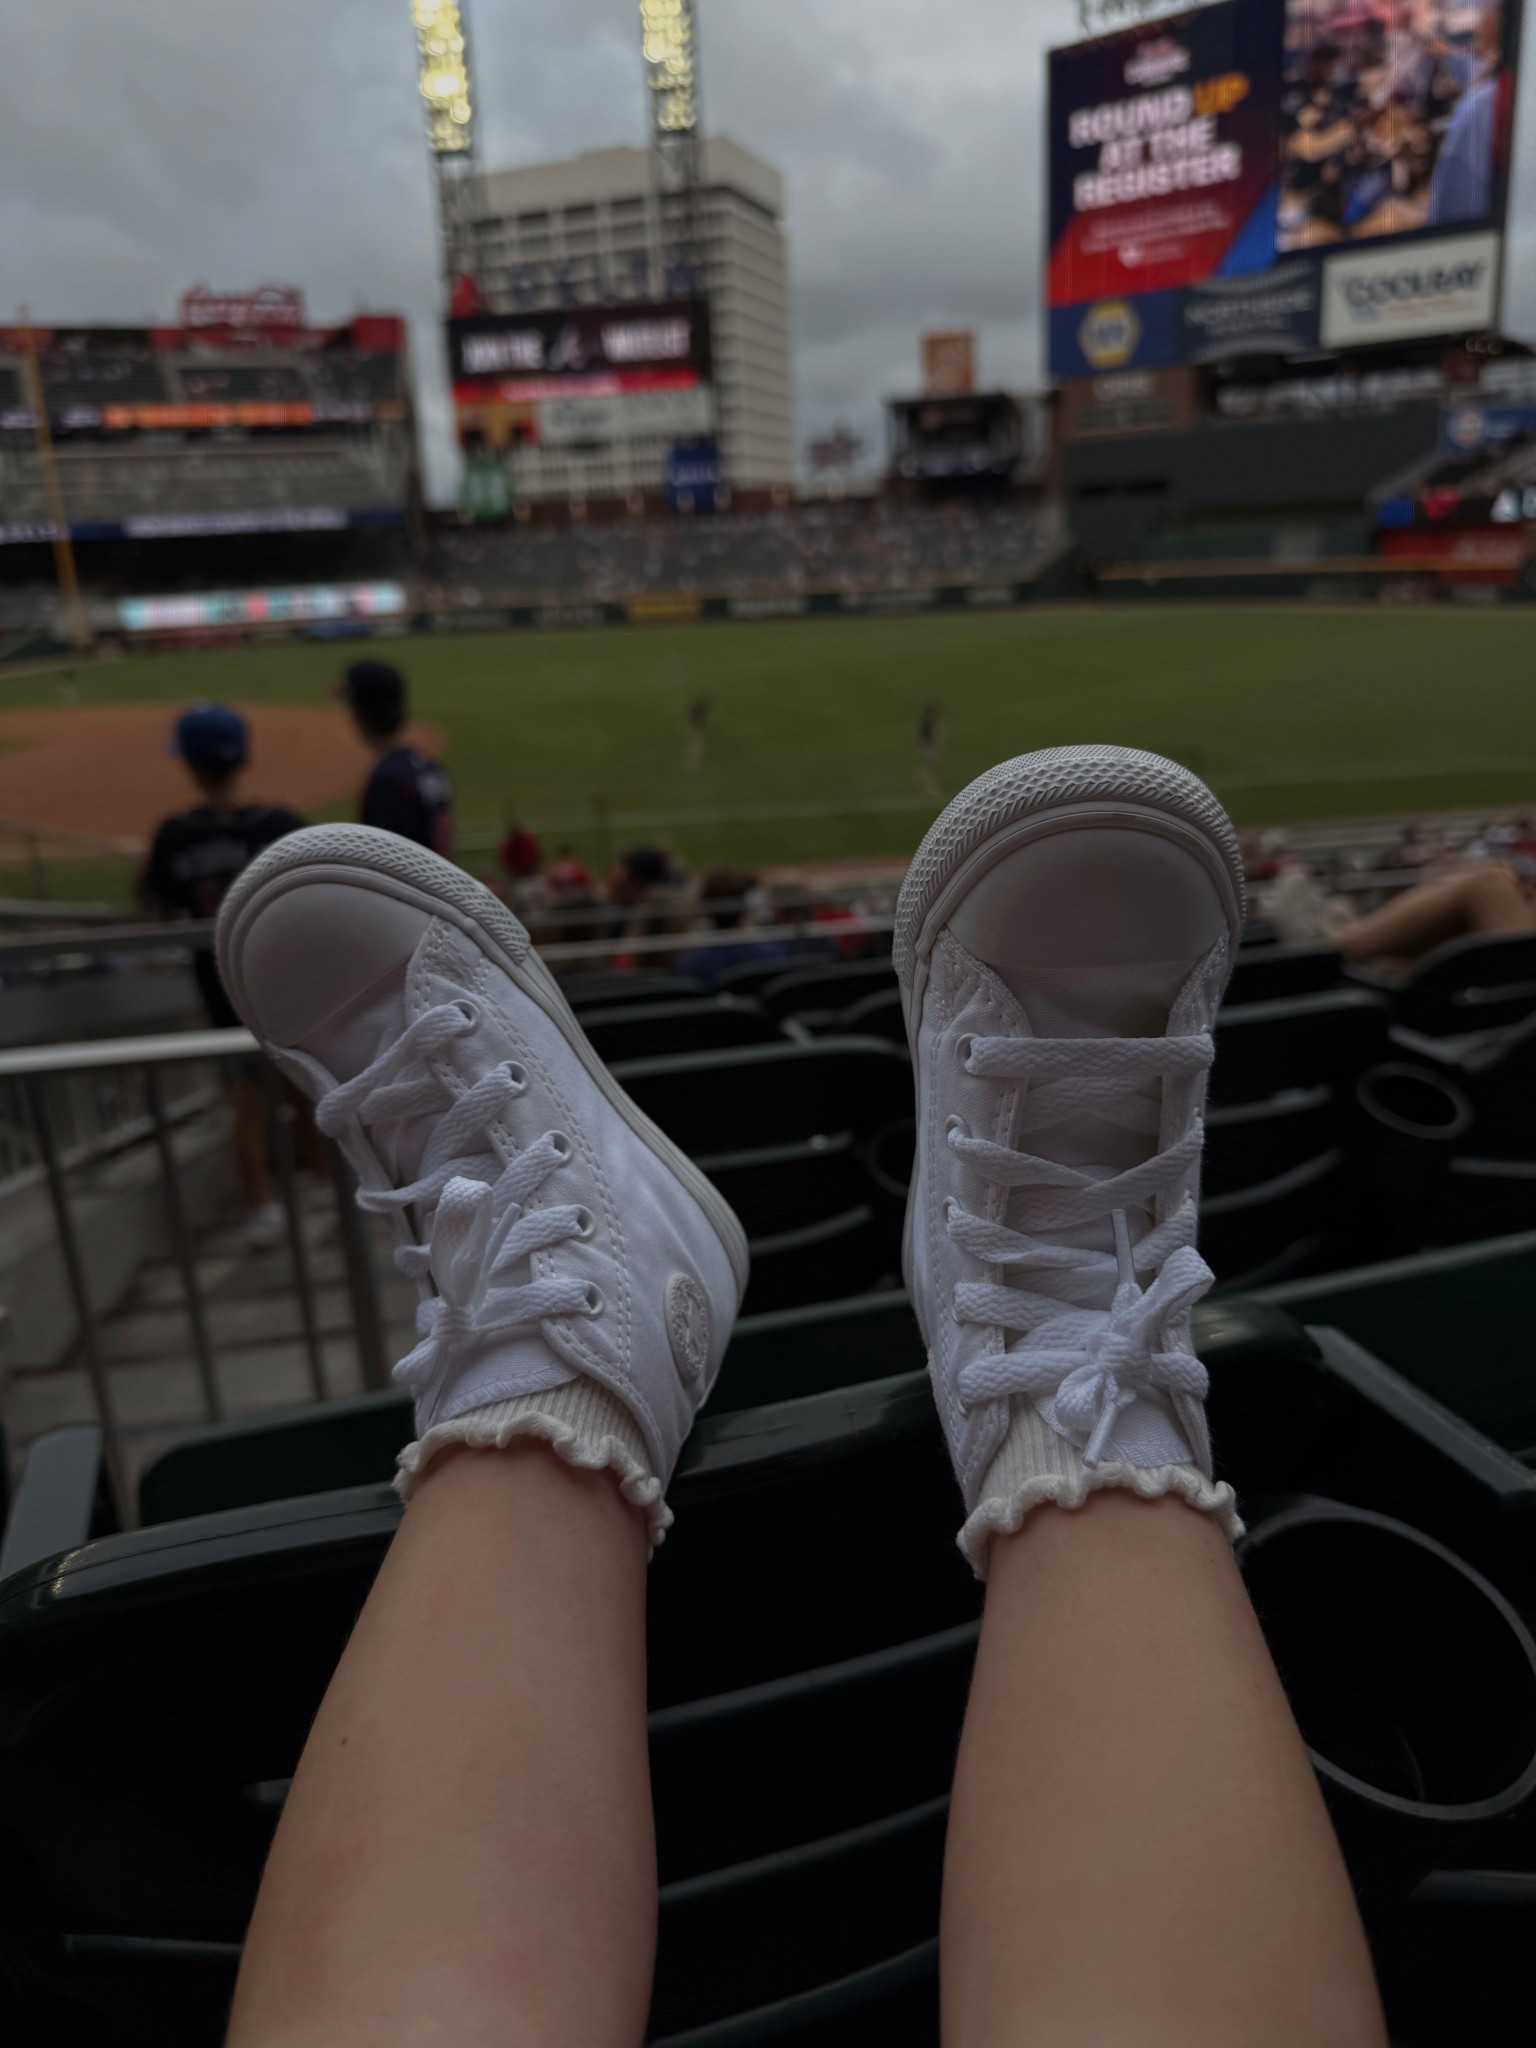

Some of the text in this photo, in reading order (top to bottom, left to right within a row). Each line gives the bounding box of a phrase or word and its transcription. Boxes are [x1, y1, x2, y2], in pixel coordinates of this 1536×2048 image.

[1069, 73, 1249, 148] ROUND UP
[1101, 115, 1217, 175] AT THE
[1074, 142, 1242, 211] REGISTER
